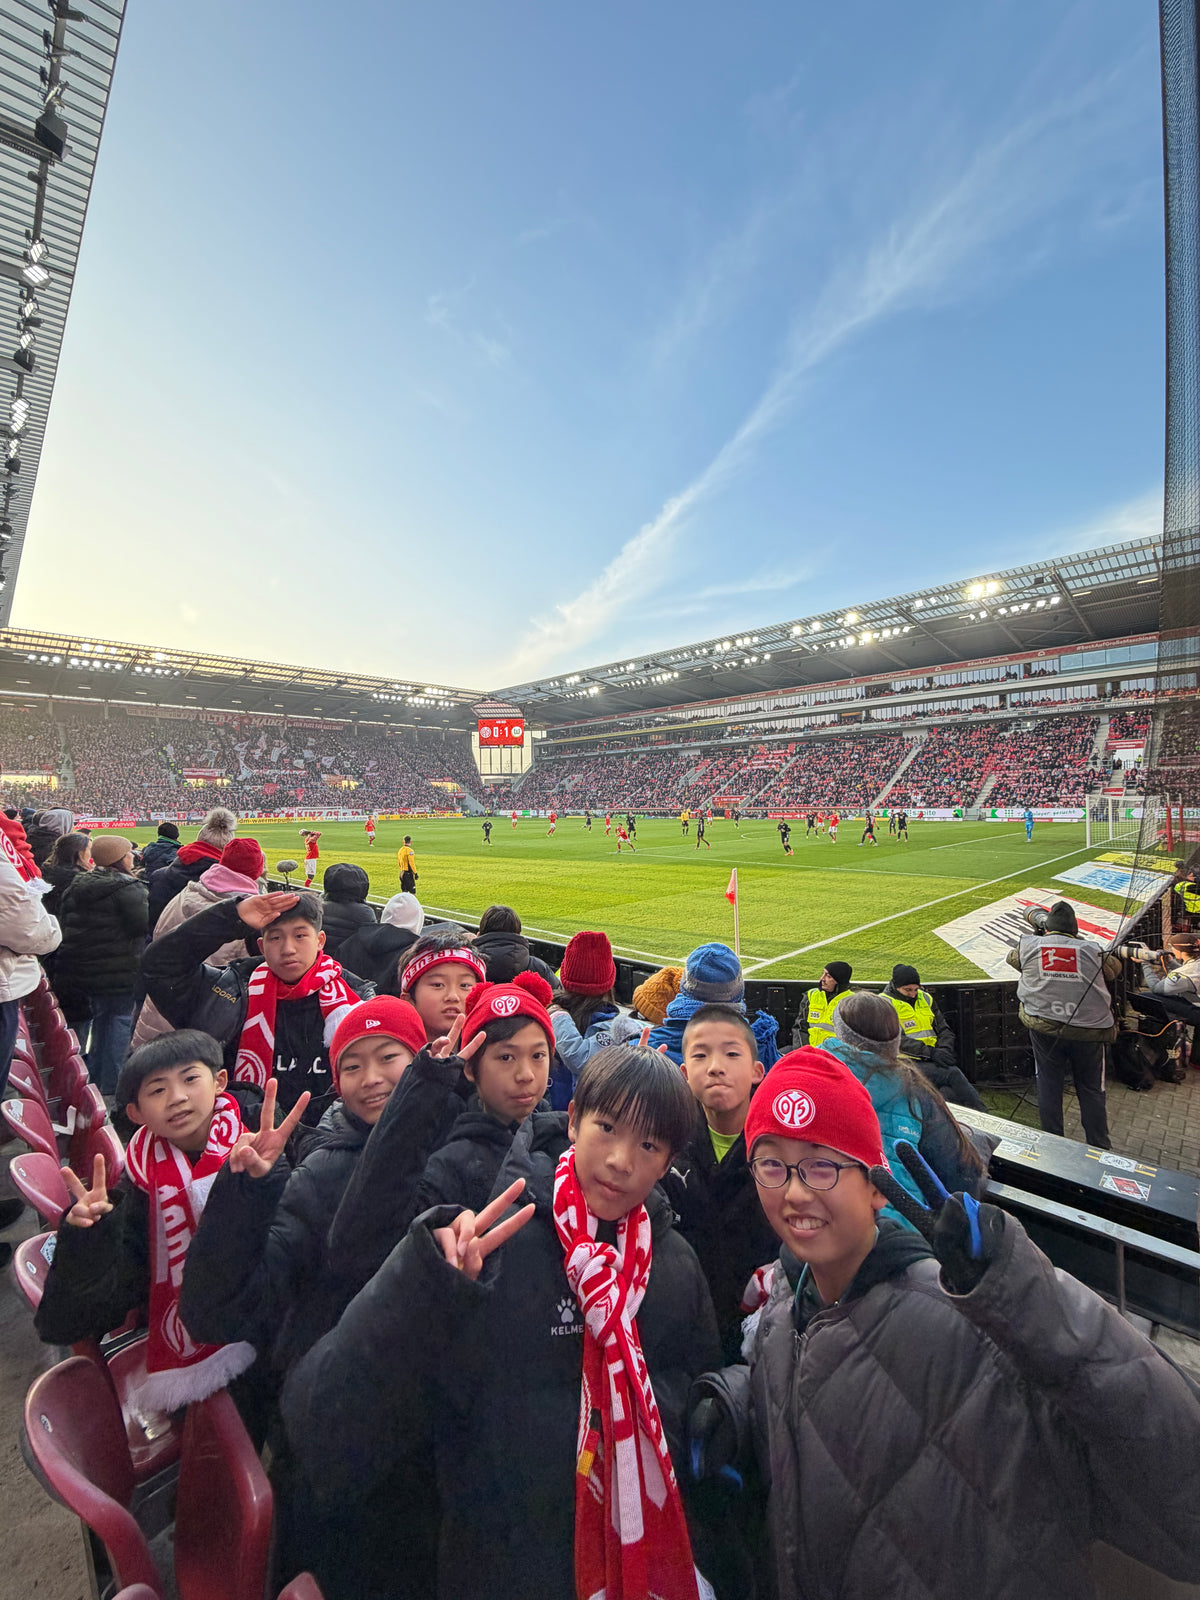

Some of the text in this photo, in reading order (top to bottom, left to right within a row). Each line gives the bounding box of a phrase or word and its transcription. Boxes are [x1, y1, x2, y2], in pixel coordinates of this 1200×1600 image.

[405, 950, 455, 982] TREUEN
[1051, 1000, 1079, 1017] 60
[550, 1325, 585, 1336] KELME
